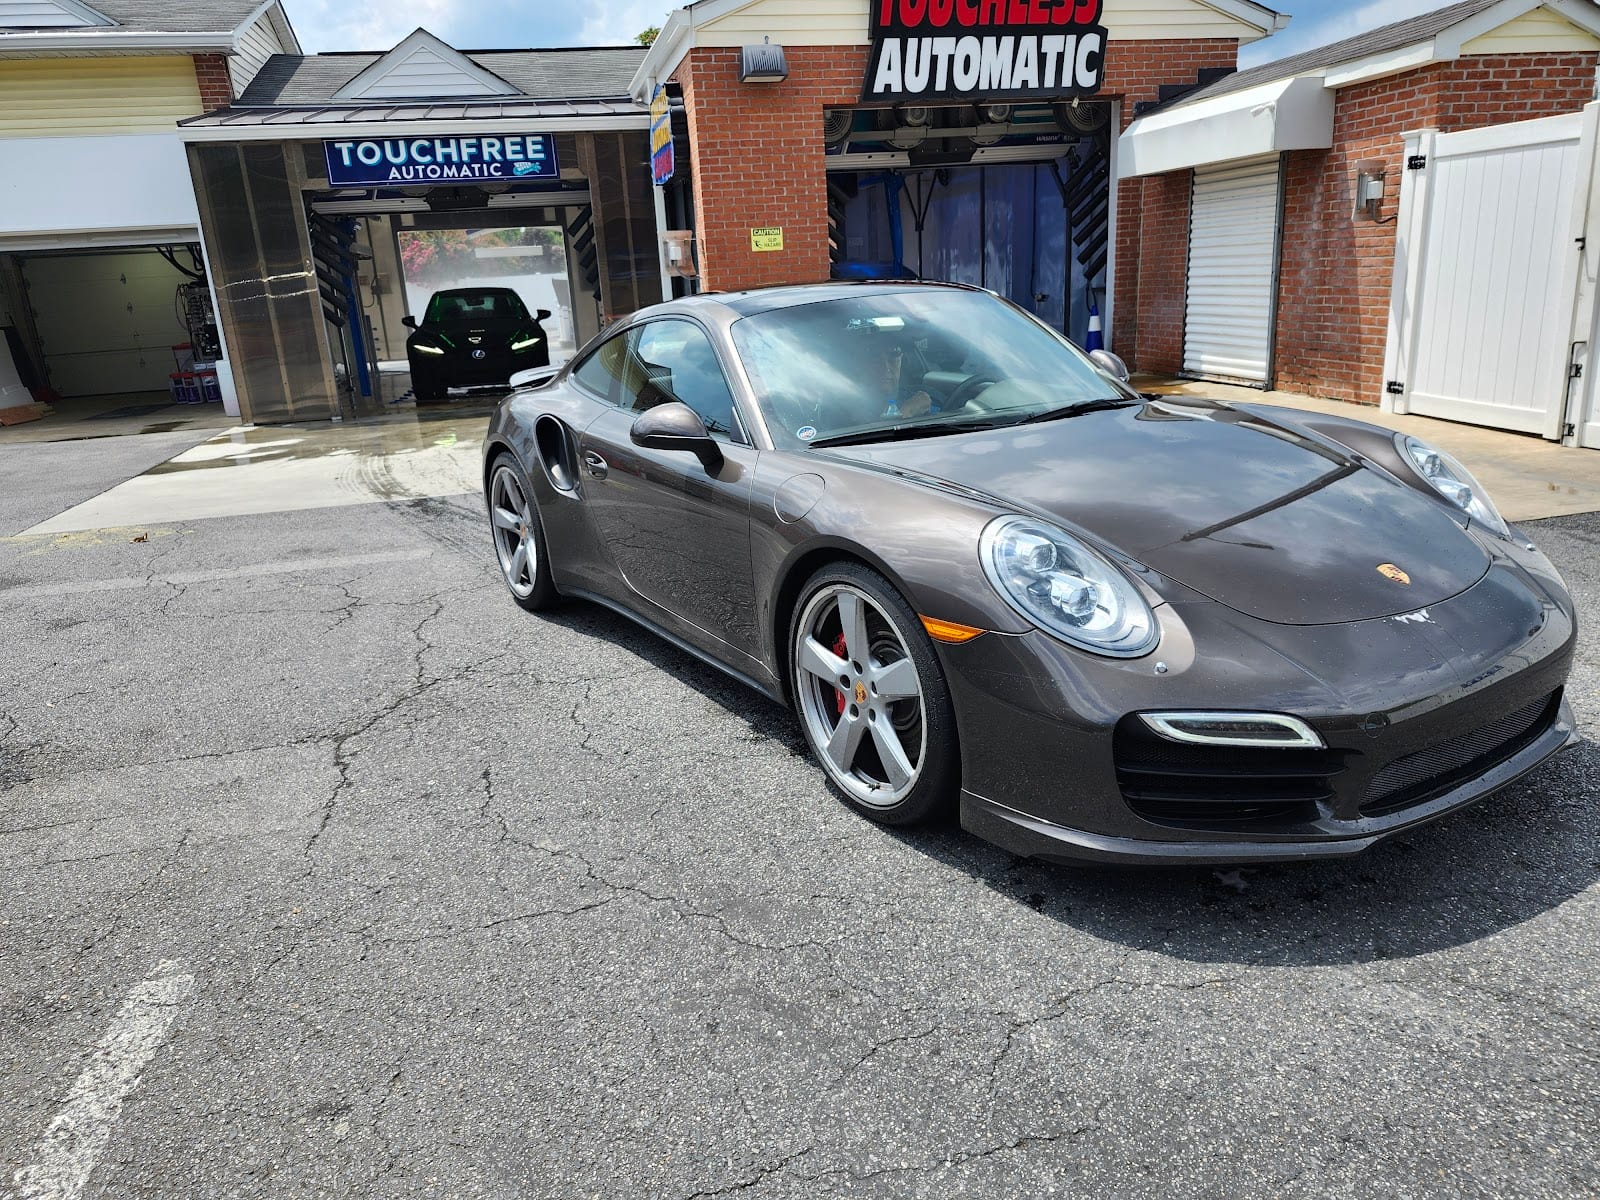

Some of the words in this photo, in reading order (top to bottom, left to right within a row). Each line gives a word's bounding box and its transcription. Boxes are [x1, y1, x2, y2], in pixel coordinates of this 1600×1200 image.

[873, 33, 1101, 93] AUTOMATIC
[335, 136, 546, 167] TOUCHFREE
[388, 162, 503, 180] AUTOMATIC
[753, 228, 780, 236] CAUTION
